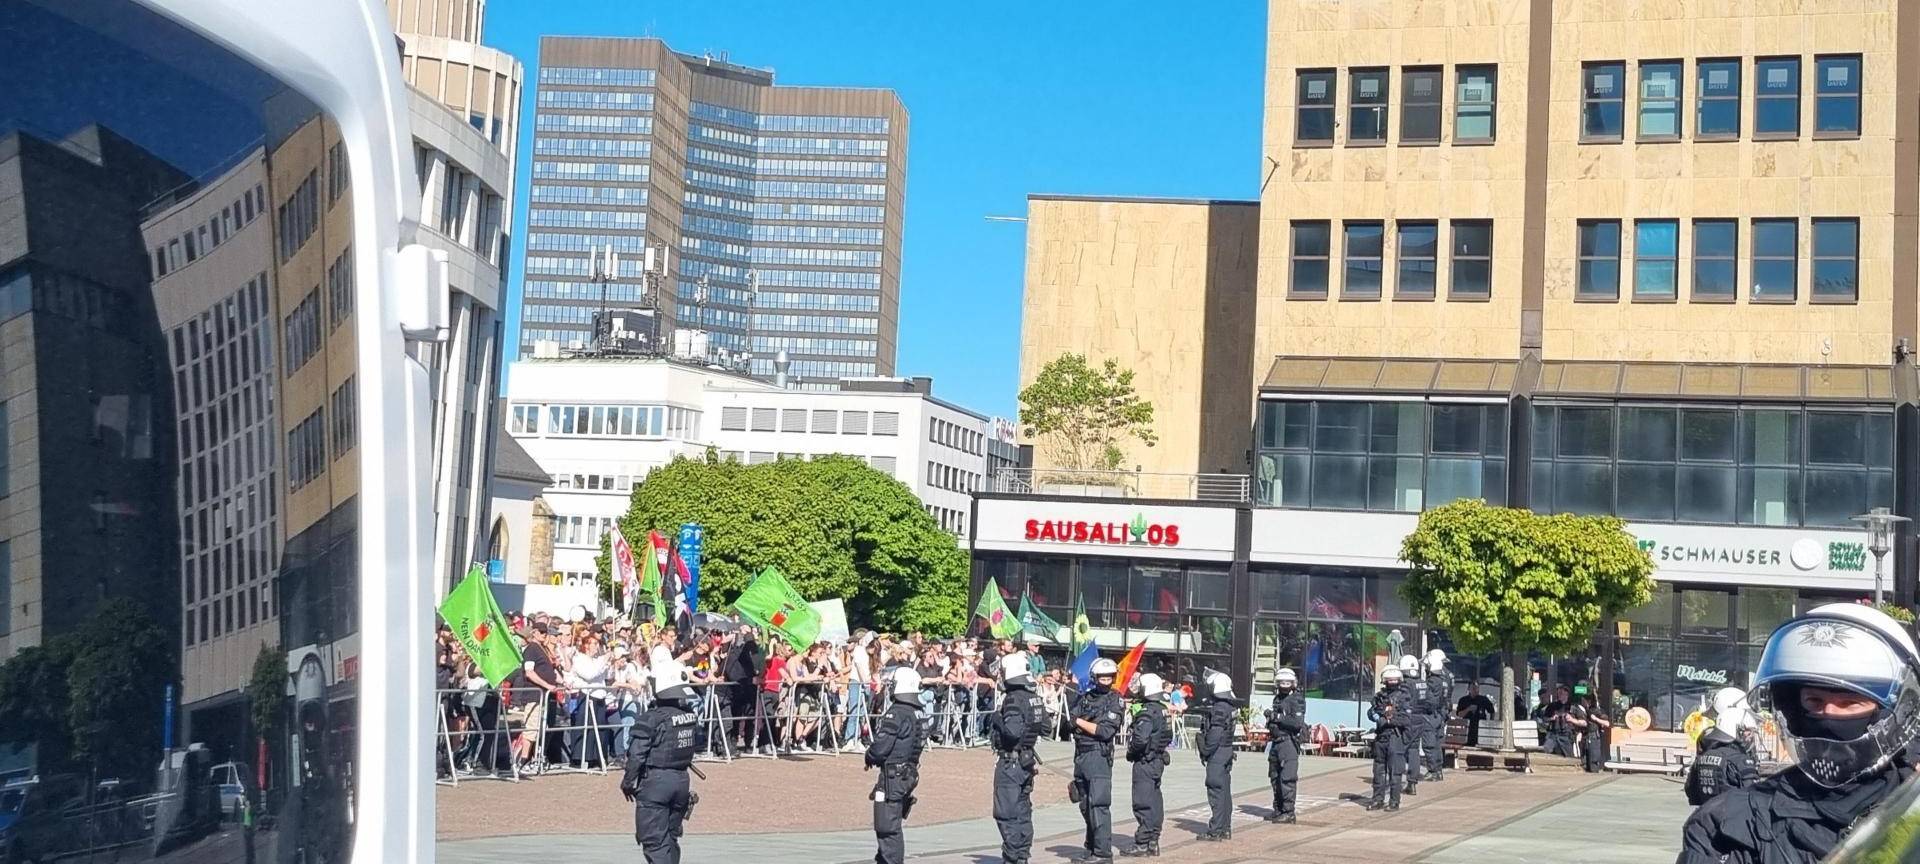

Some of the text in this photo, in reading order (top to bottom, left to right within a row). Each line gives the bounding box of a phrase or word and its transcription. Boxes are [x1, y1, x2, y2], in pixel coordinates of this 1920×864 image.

[1661, 545, 1781, 565] SCHMAUSER
[461, 617, 470, 641] NEIN
[466, 640, 490, 657] DANKE
